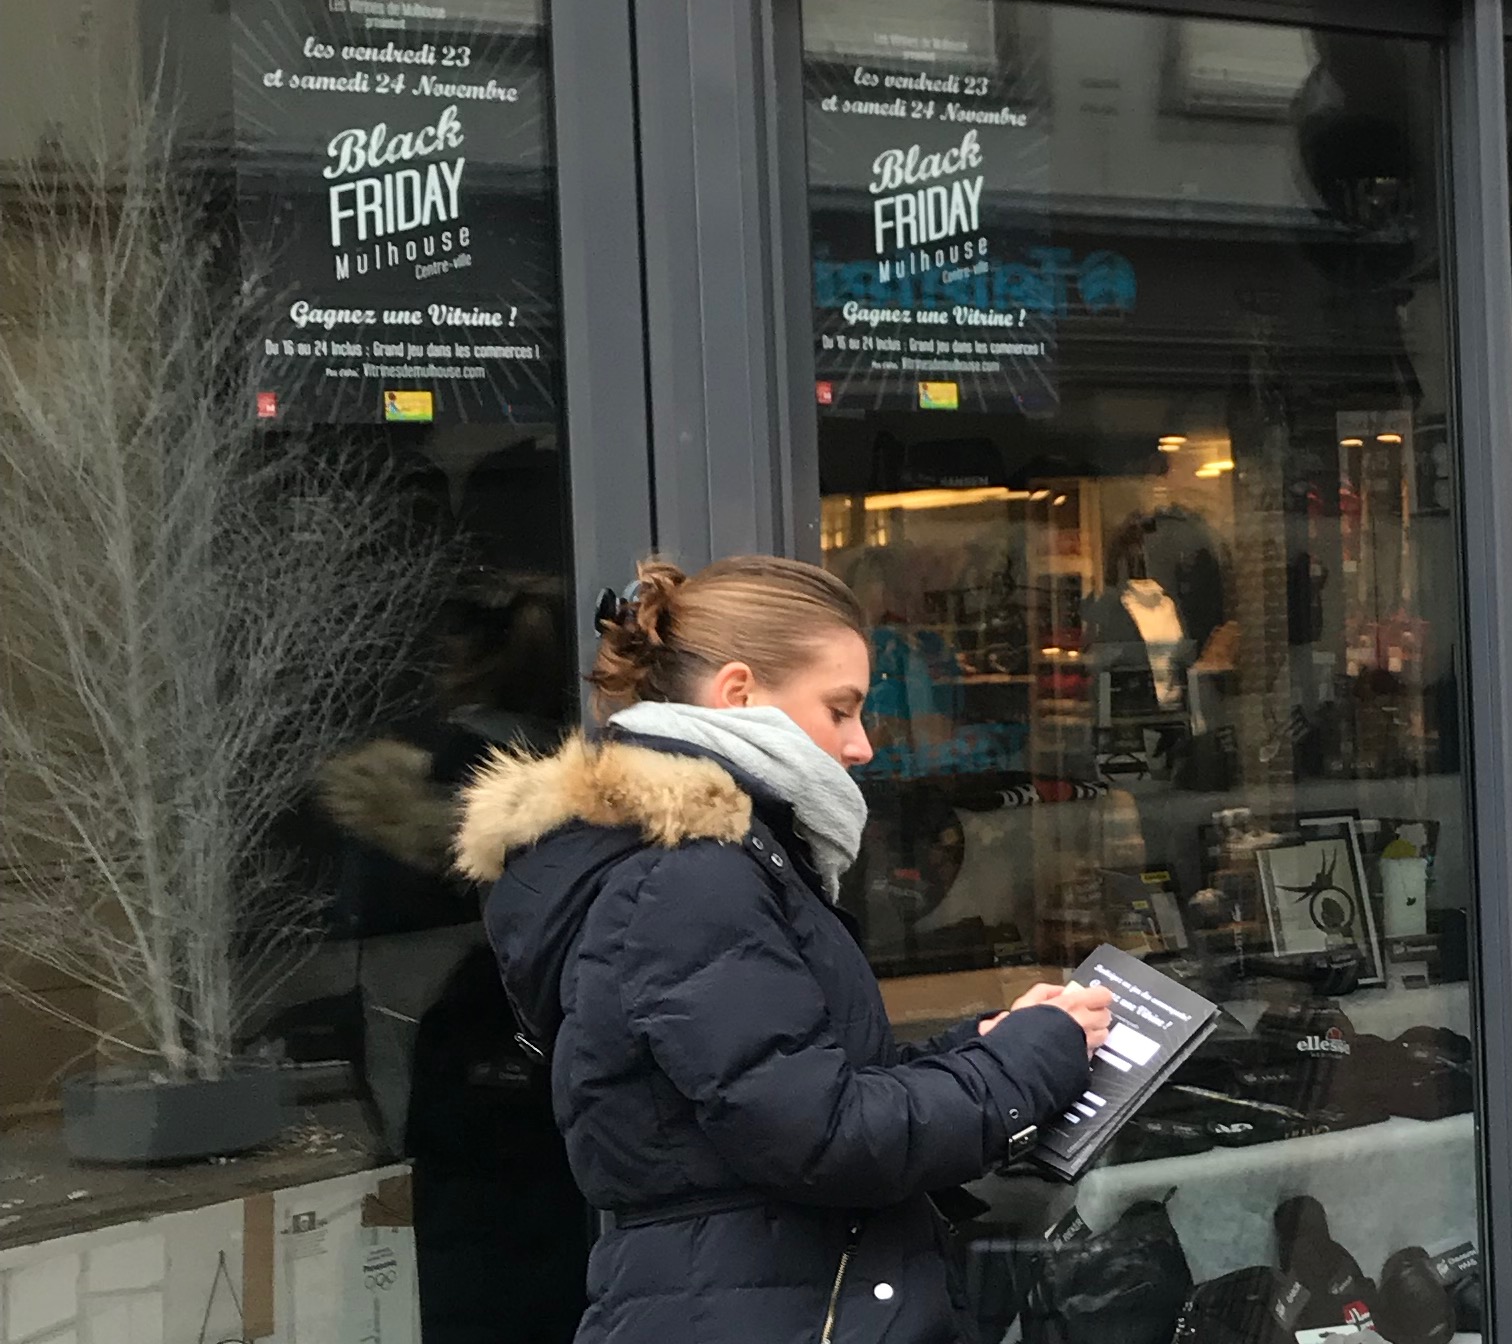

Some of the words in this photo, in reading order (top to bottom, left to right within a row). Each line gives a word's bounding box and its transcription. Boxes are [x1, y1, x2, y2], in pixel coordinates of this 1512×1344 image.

[341, 41, 437, 66] vendredi
[441, 45, 471, 67] 23
[288, 71, 370, 93] samedi
[375, 72, 406, 94] 24
[412, 75, 519, 102] Novembre
[884, 72, 960, 94] vendredi
[963, 75, 990, 96] 23
[842, 98, 907, 118] samedi
[911, 100, 935, 120] 24
[940, 102, 1028, 127] Novembre
[322, 104, 466, 180] Black
[868, 129, 984, 194] Black
[329, 157, 466, 247] FRIDAY
[874, 176, 984, 254] FRIDAY
[334, 225, 471, 281] Mulhouse
[878, 237, 988, 284] Mulhouse
[290, 300, 377, 330] Gagnez
[383, 308, 423, 325] une
[428, 304, 504, 327] Vitrine
[507, 306, 518, 327] !
[843, 300, 912, 328] Gagnez
[916, 308, 948, 325] une
[952, 305, 1014, 327] Vitrine
[1017, 308, 1026, 327] !
